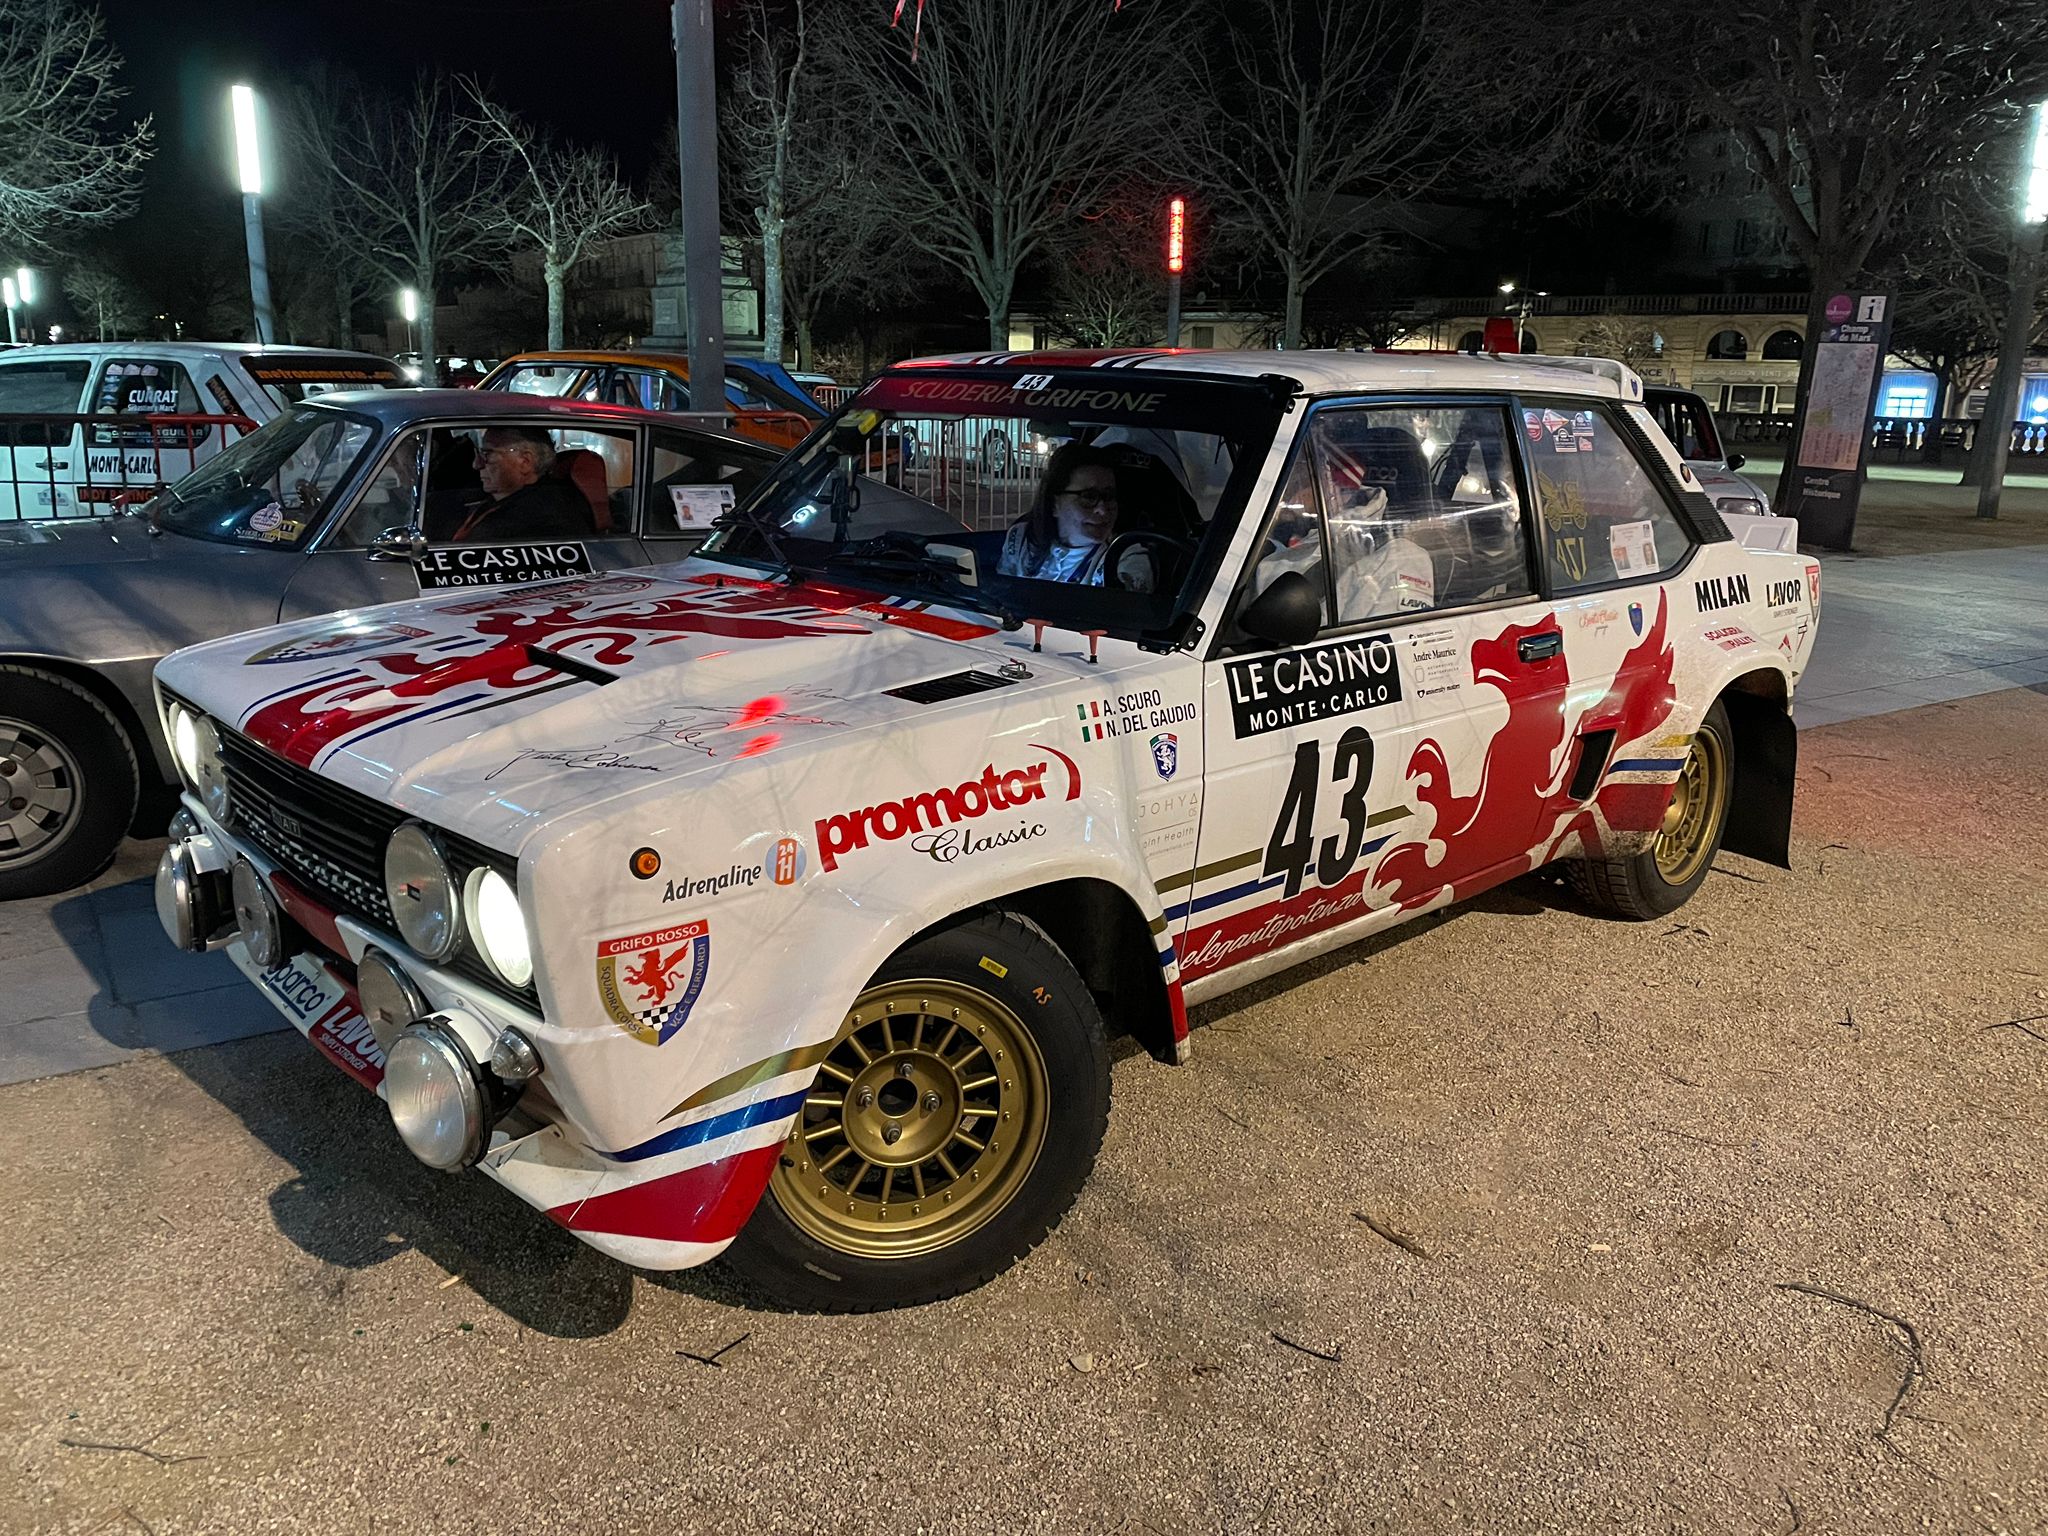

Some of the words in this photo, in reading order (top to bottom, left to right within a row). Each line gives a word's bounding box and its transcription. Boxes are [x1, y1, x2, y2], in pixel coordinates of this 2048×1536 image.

[129, 389, 179, 403] CURRAT
[901, 381, 1020, 405] SCUDERIA
[1023, 387, 1167, 413] GRIFONE
[1021, 374, 1047, 390] 43
[421, 550, 452, 572] LE
[458, 544, 580, 570] CASINO
[434, 572, 503, 586] MONTE
[1694, 573, 1751, 613] MILAN
[1766, 579, 1802, 608] LAVOR
[1432, 647, 1457, 660] Maurice
[1231, 662, 1269, 704] LE
[1273, 639, 1392, 694] CASINO
[1103, 699, 1117, 717] A.
[1118, 689, 1161, 713] SCURO
[1249, 702, 1318, 732] MONTE
[1329, 684, 1389, 712] CARLO
[1106, 719, 1121, 738] N.
[1122, 714, 1148, 734] DEL
[1150, 703, 1196, 728] GAUDIO
[814, 762, 1047, 873] promotor
[1261, 726, 1375, 900] 43
[778, 842, 794, 857] 24
[910, 820, 1048, 864] Classic
[1164, 827, 1194, 841] Health
[662, 863, 762, 903] Adrenaline
[609, 935, 653, 953] GRIFO
[655, 924, 700, 944] ROSSO
[689, 943, 706, 995] BERNARDI
[266, 961, 325, 1012] parco
[600, 966, 620, 1012] SQUADRA
[616, 1011, 643, 1035] CORSE
